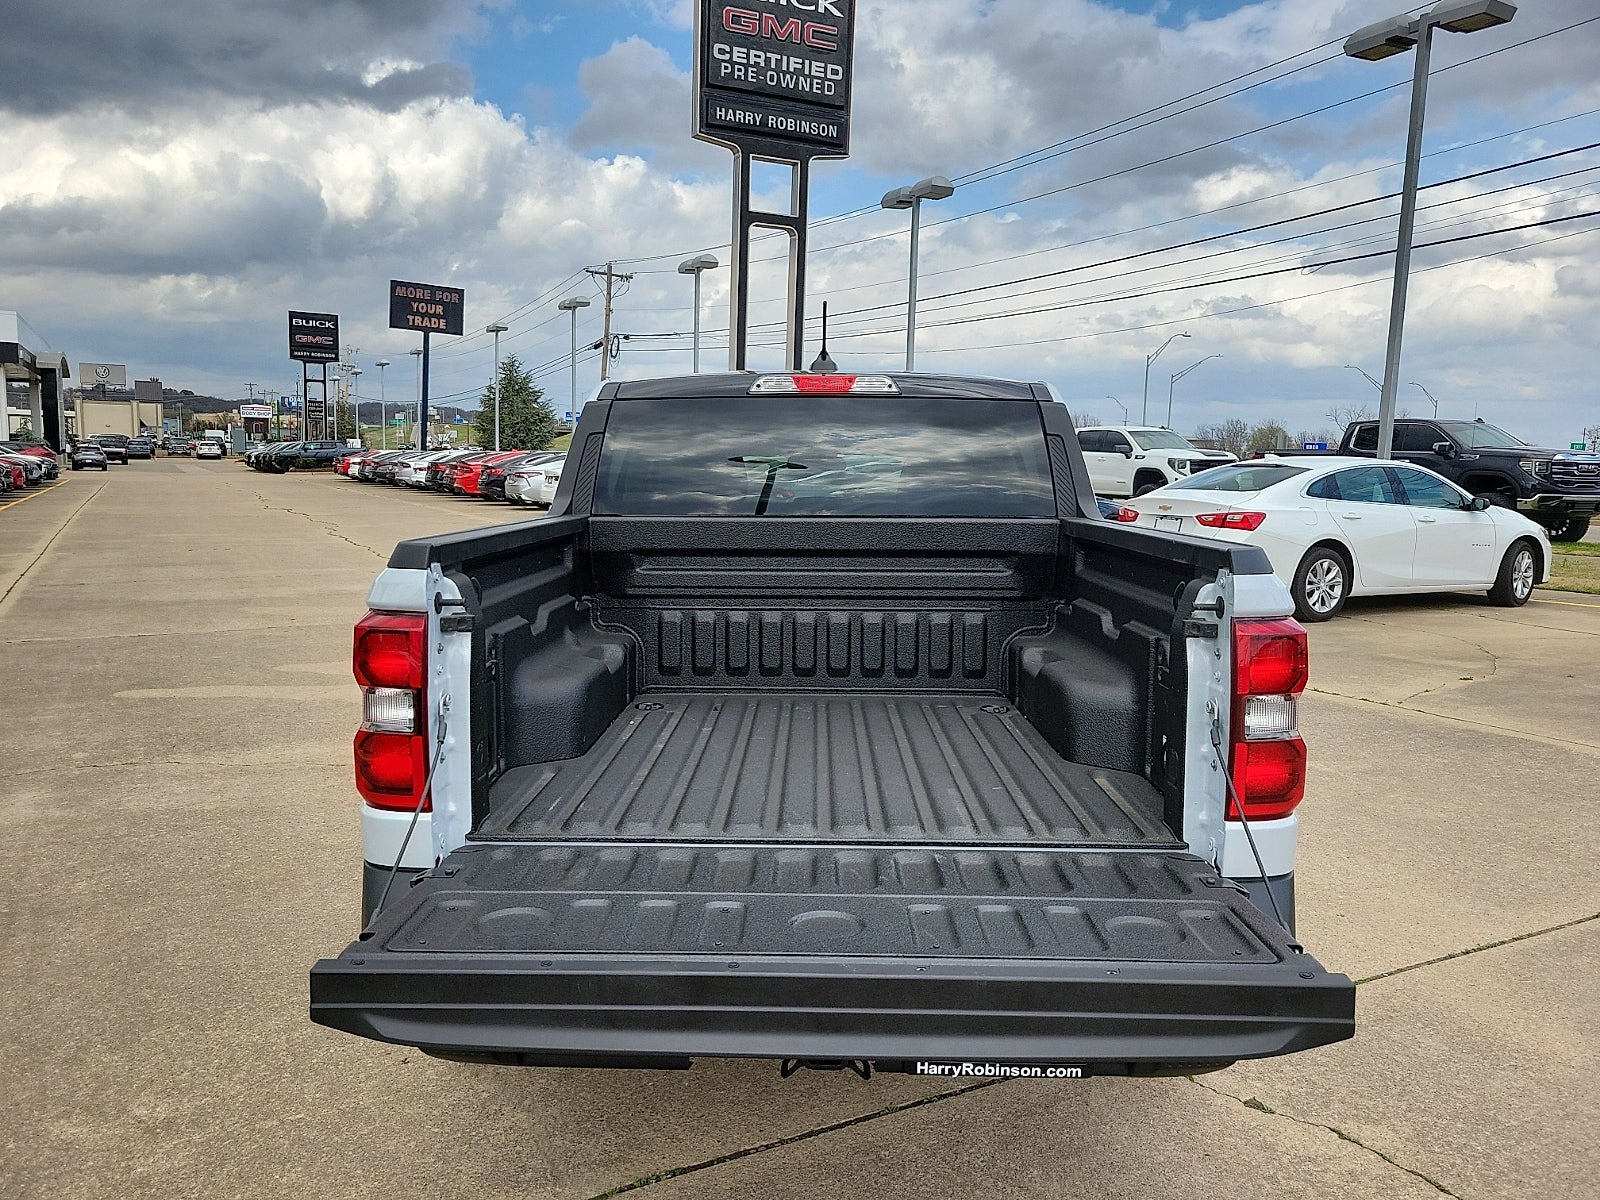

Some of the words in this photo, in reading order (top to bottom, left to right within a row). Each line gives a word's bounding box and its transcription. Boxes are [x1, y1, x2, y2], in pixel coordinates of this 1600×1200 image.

[722, 6, 838, 50] GMC
[713, 43, 843, 80] CERTIFIED
[720, 62, 835, 96] PRE-OWNED
[716, 107, 763, 126] HARRY
[768, 116, 838, 137] ROBINSON
[395, 286, 431, 299] MORE
[435, 290, 460, 303] FOR
[411, 301, 444, 315] YOUR
[292, 318, 336, 329] BUICK
[407, 315, 447, 329] TRADE
[295, 334, 334, 345] GMC
[916, 1061, 1082, 1078] HarryRobinson.com
